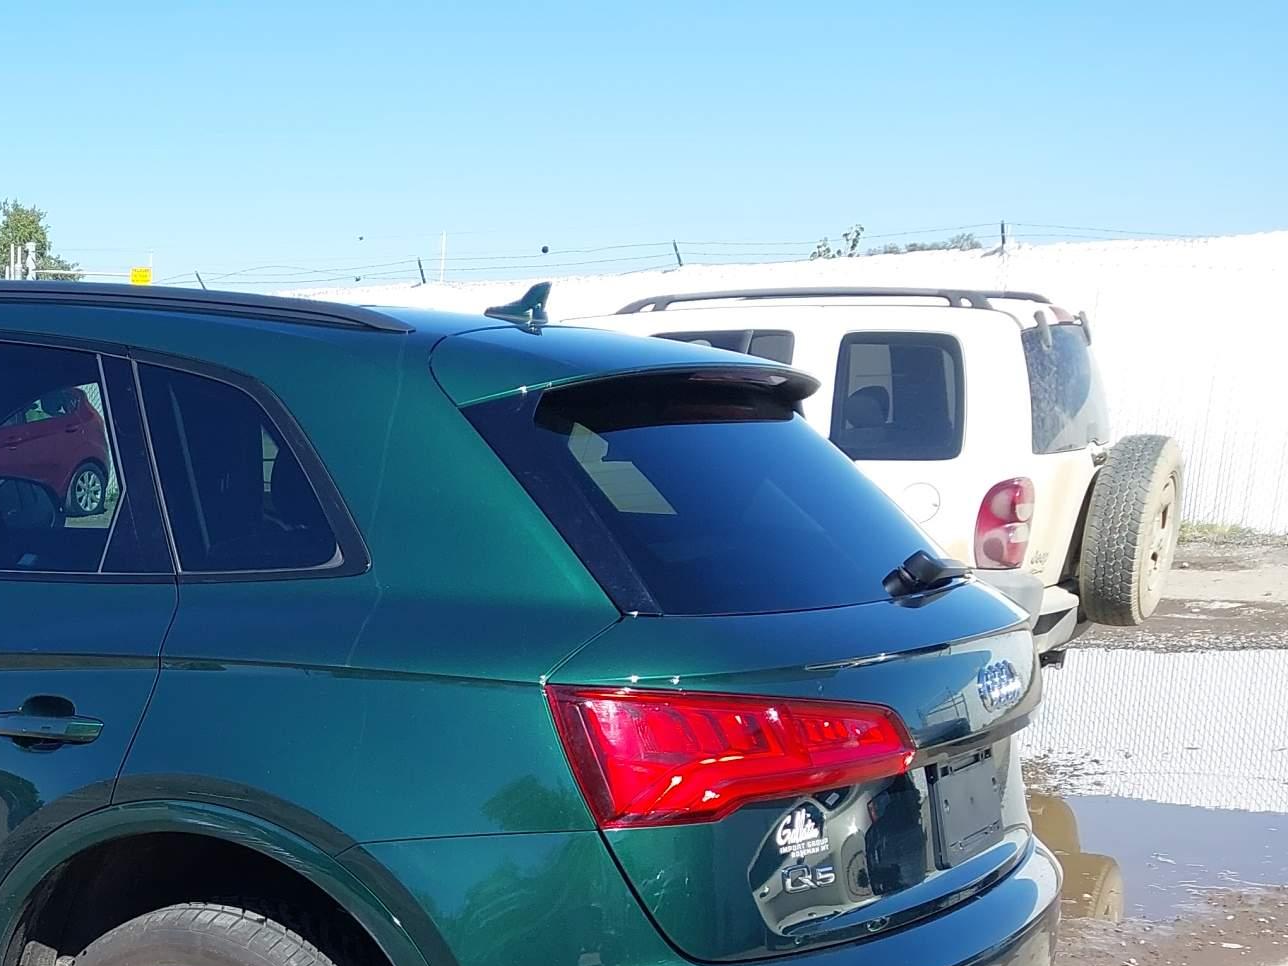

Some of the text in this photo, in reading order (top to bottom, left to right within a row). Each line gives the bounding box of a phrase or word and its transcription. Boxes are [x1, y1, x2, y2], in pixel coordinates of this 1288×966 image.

[779, 838, 829, 855] IMPORT GROUP
[781, 864, 836, 894] Q5
